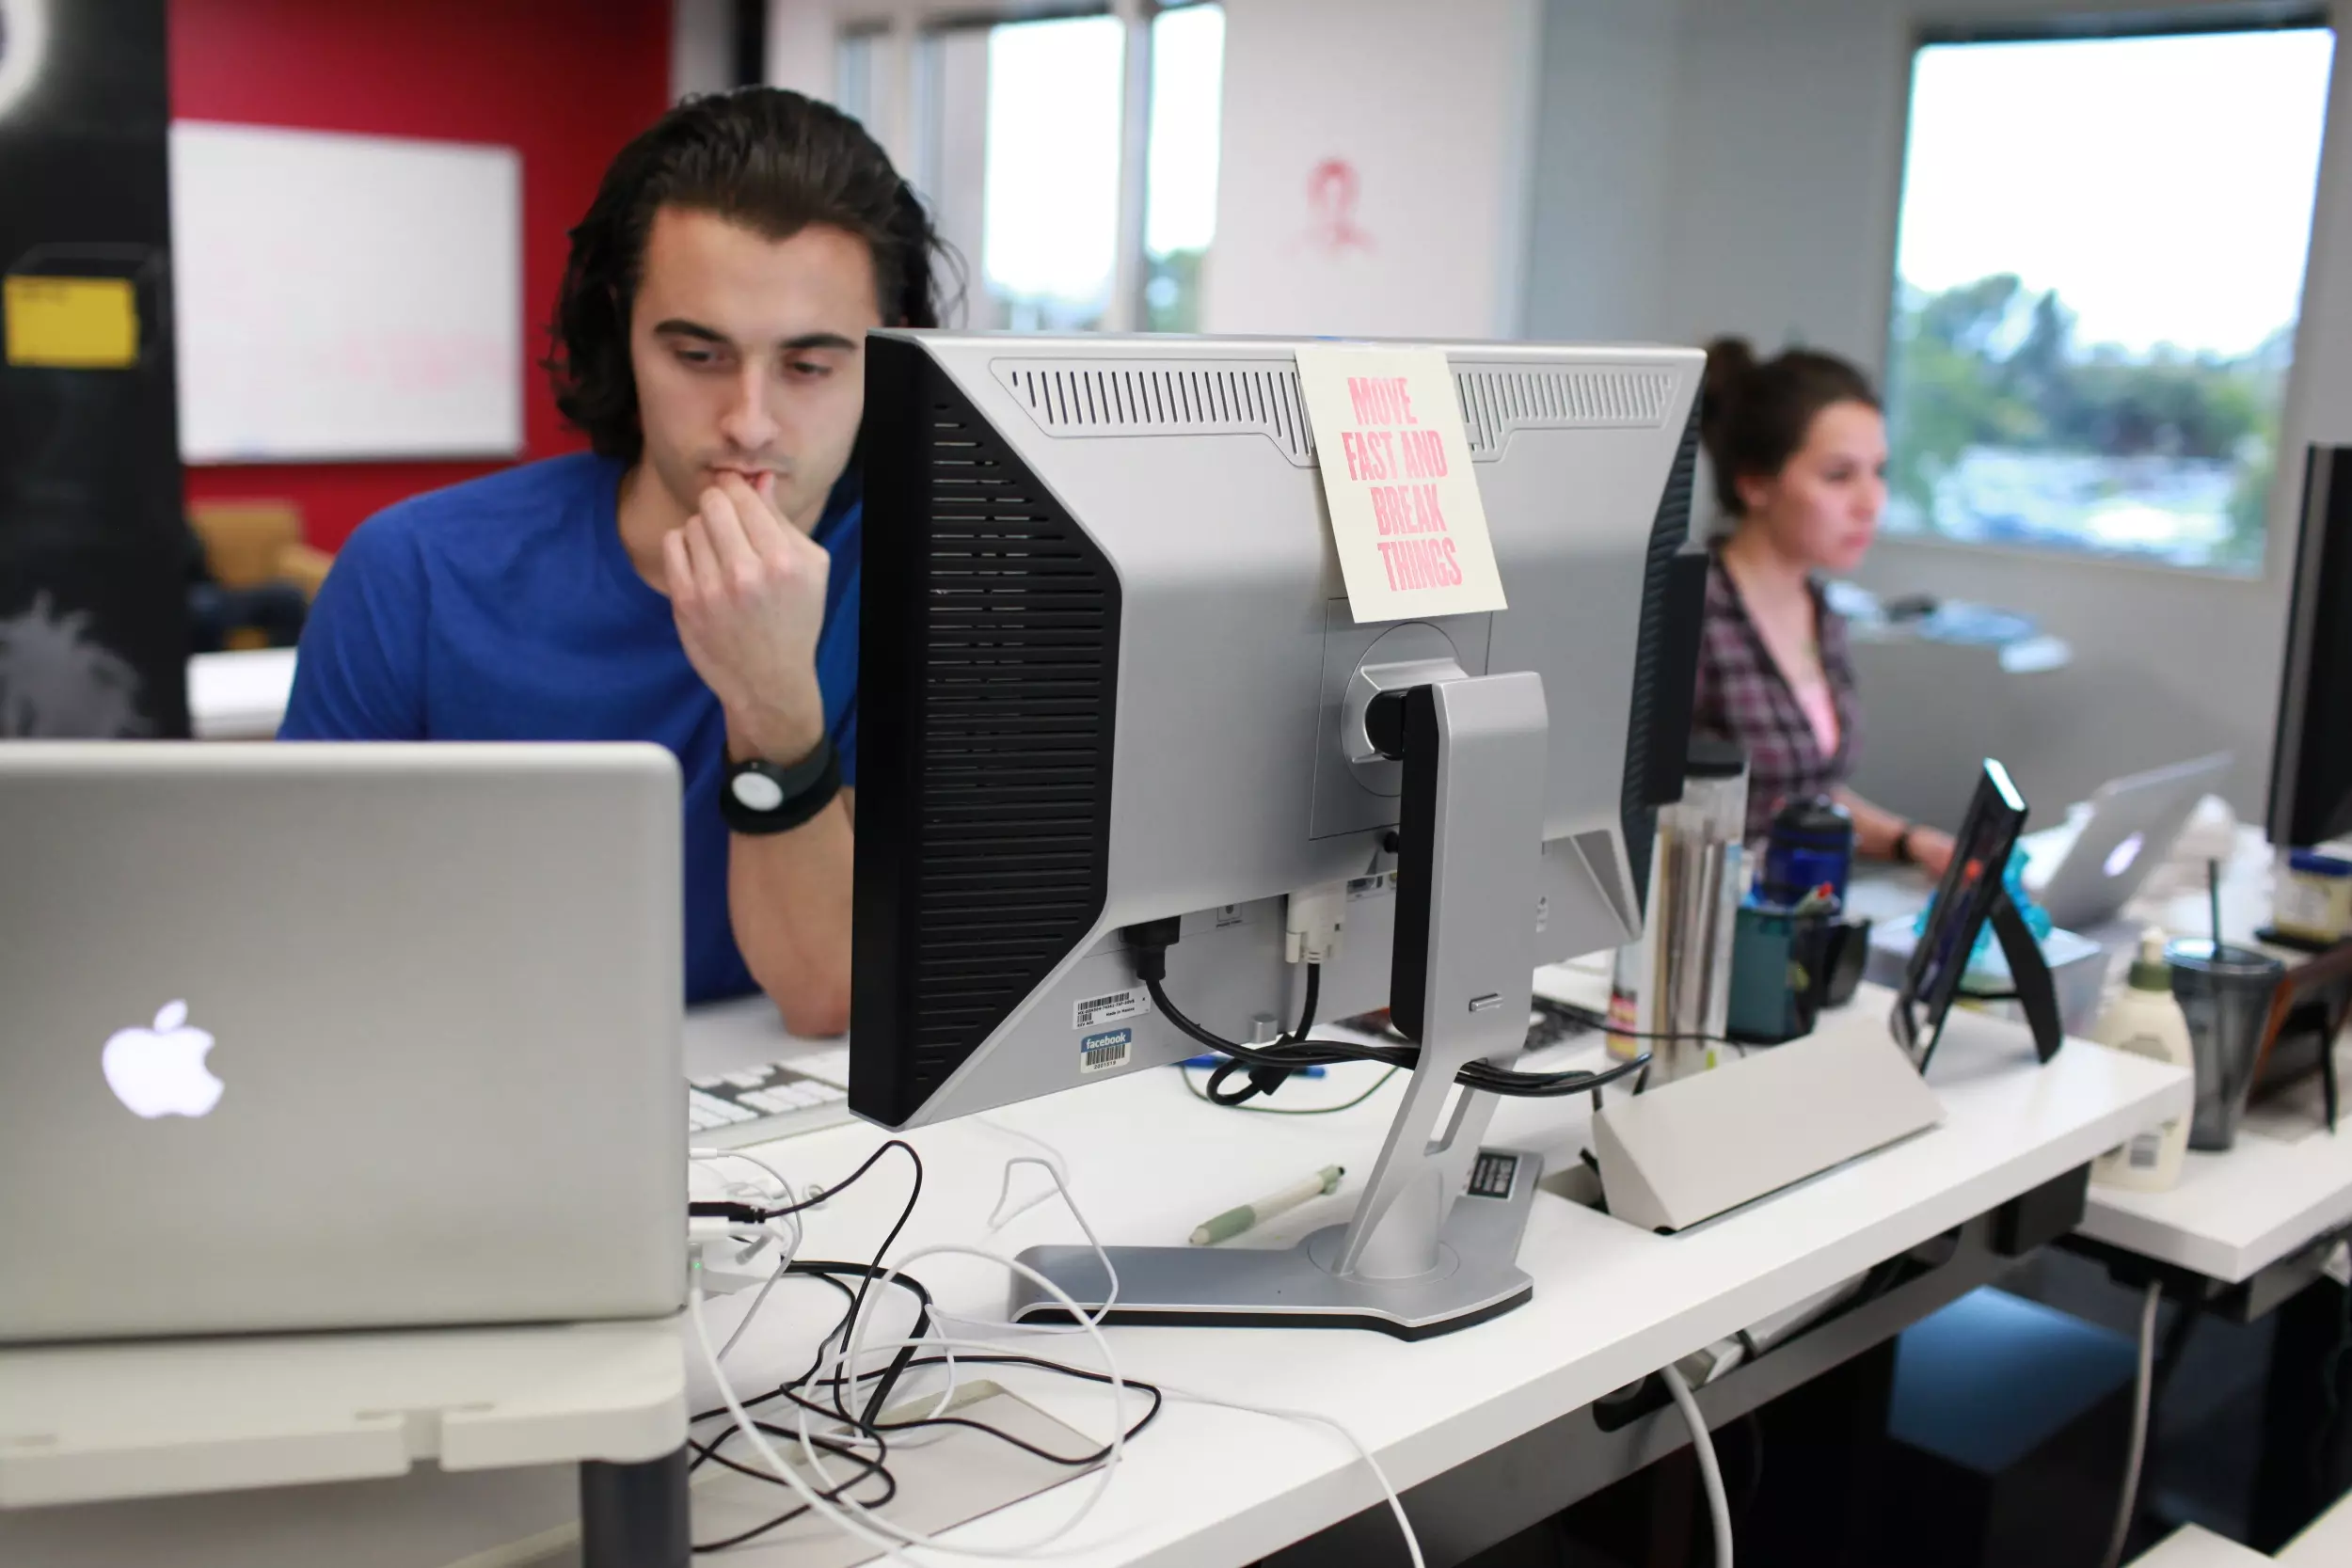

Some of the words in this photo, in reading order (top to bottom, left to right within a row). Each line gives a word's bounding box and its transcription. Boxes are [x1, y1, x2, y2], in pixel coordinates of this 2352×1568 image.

[1347, 377, 1418, 425] MOVE
[1342, 431, 1398, 481] FAST
[1400, 430, 1448, 479] AND
[1370, 483, 1447, 536] BREAK
[1376, 537, 1463, 592] THINGS
[1087, 1032, 1126, 1049] facebook
